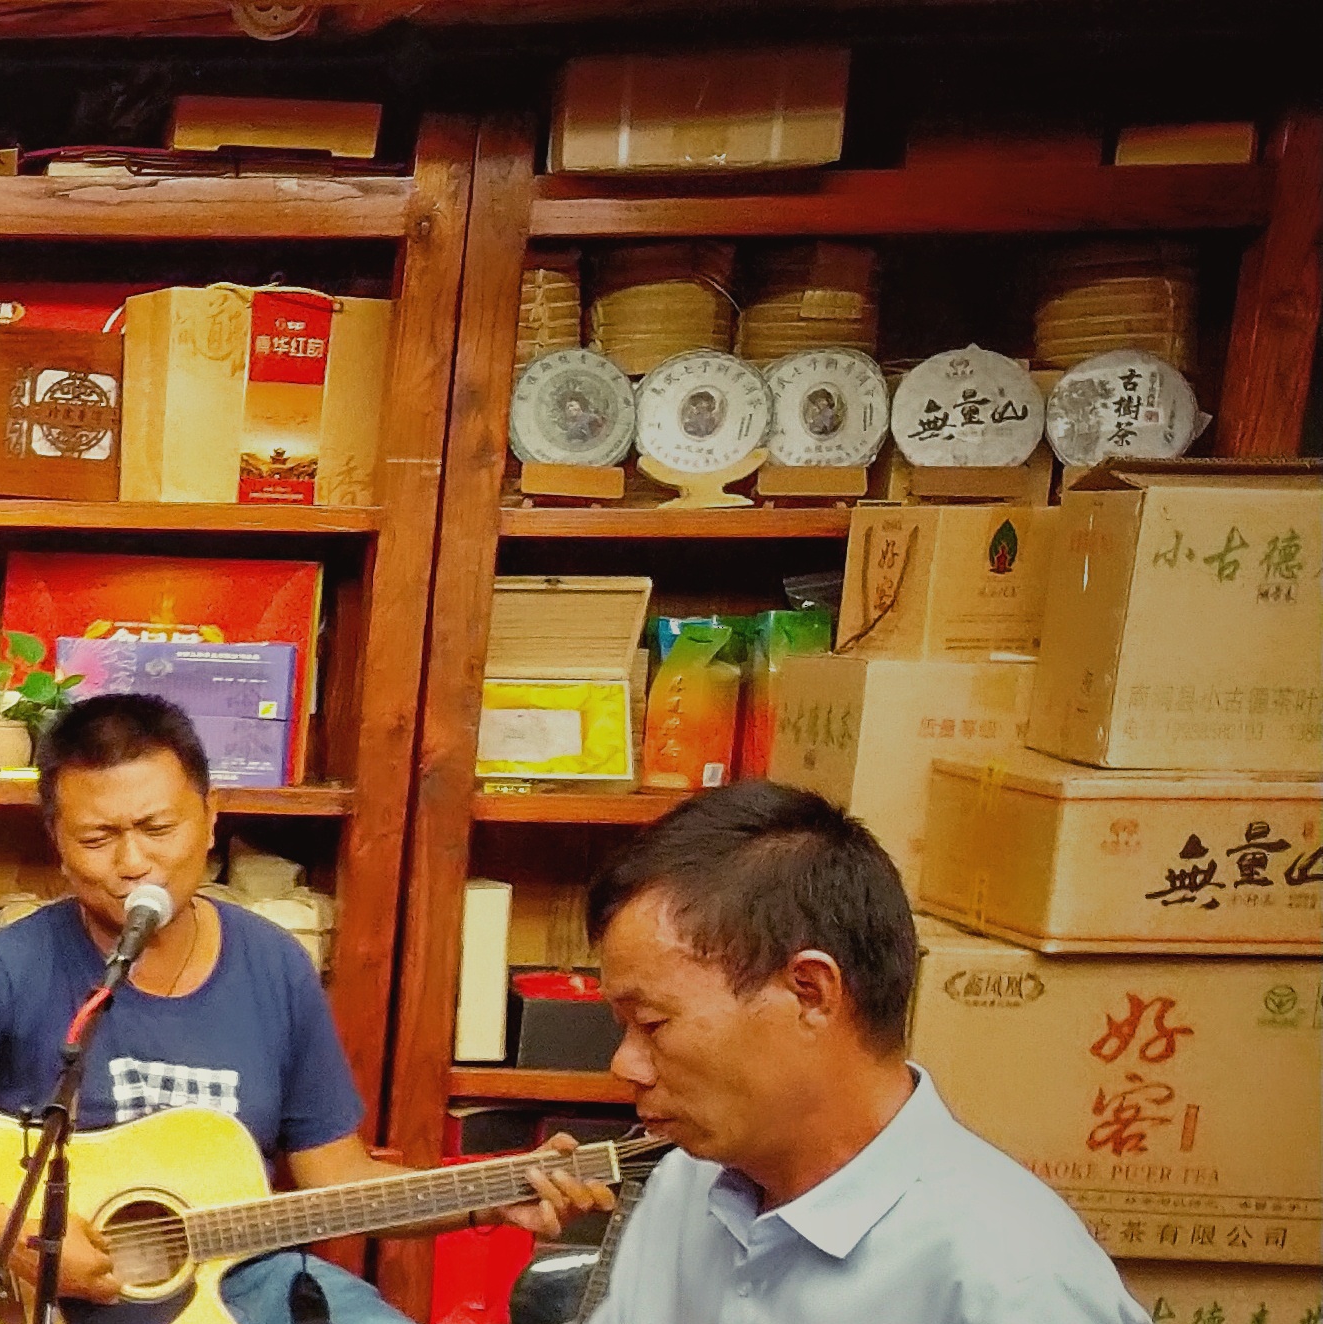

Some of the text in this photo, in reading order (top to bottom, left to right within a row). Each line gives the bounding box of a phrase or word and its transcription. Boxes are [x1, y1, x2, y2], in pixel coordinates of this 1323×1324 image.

[908, 388, 1028, 441] 無量山
[1108, 368, 1142, 447] 古樹茶
[1153, 525, 1323, 583] 小古德
